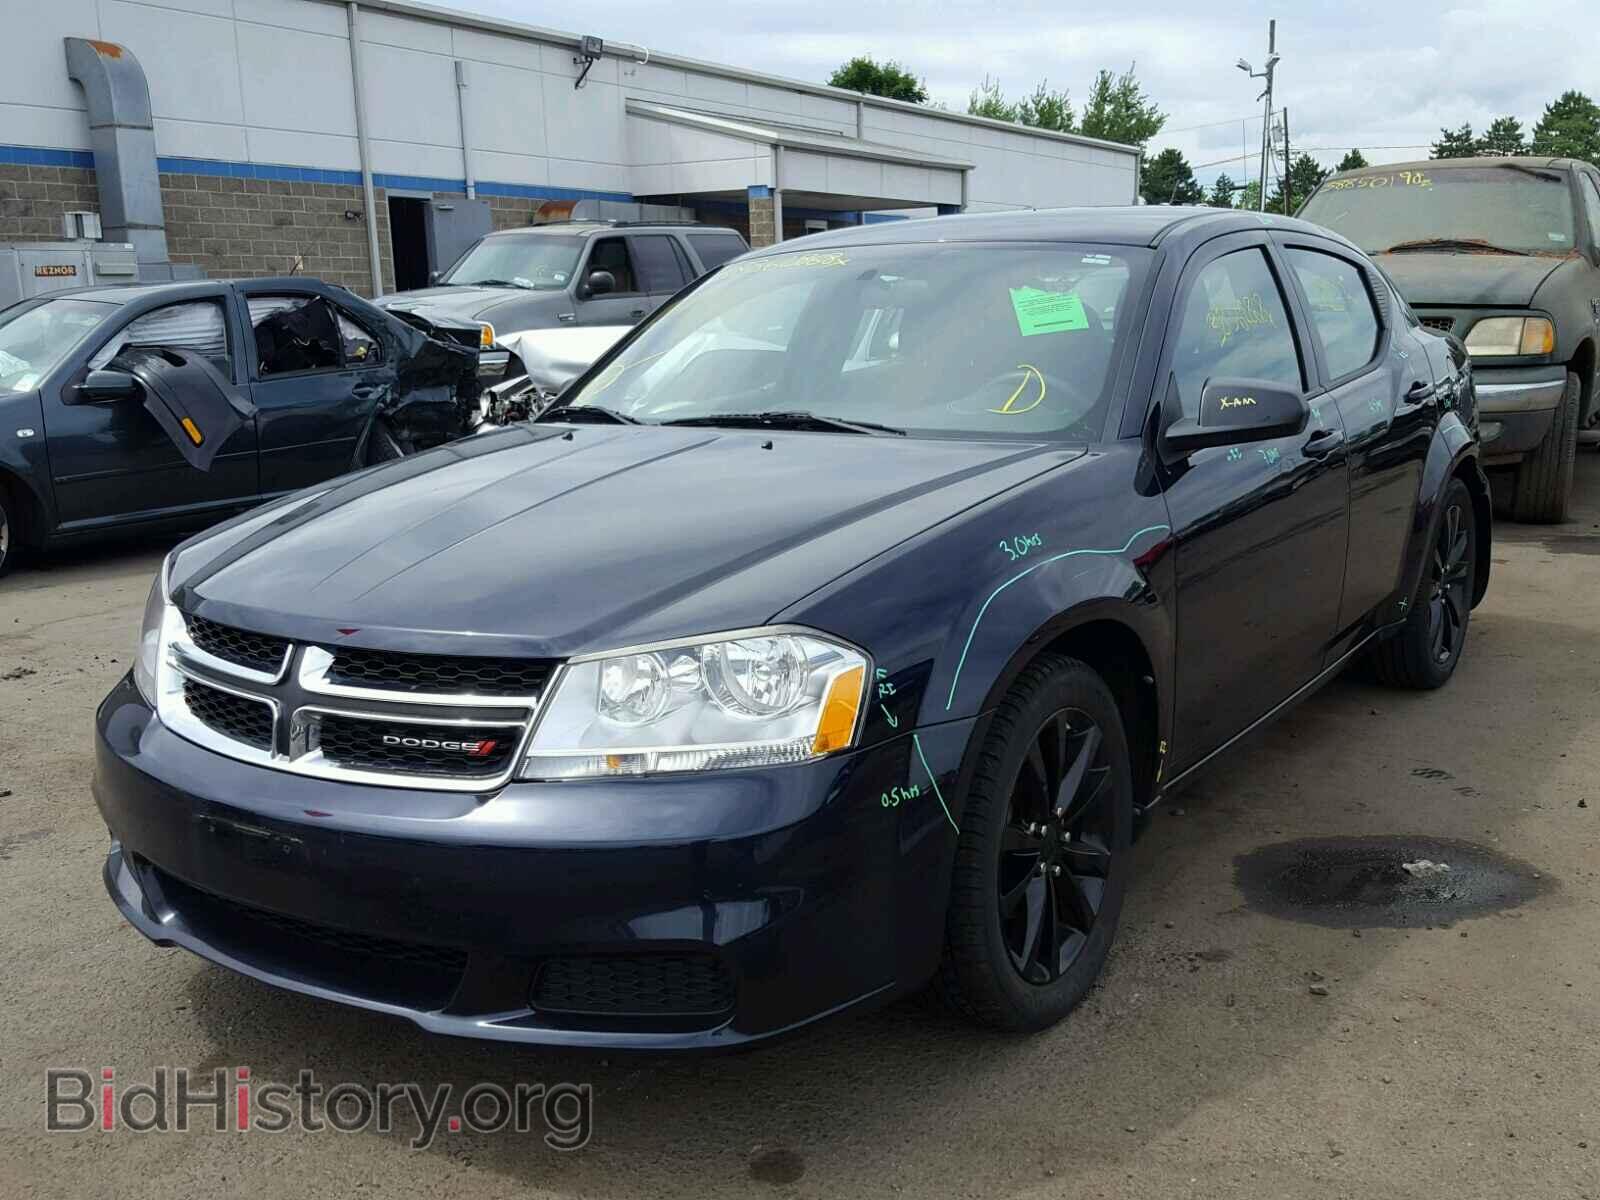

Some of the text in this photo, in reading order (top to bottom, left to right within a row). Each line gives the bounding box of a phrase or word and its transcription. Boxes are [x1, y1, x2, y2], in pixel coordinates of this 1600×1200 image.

[36, 266, 75, 275] REZNOR
[984, 364, 1046, 414] D
[383, 735, 480, 751] DODGE
